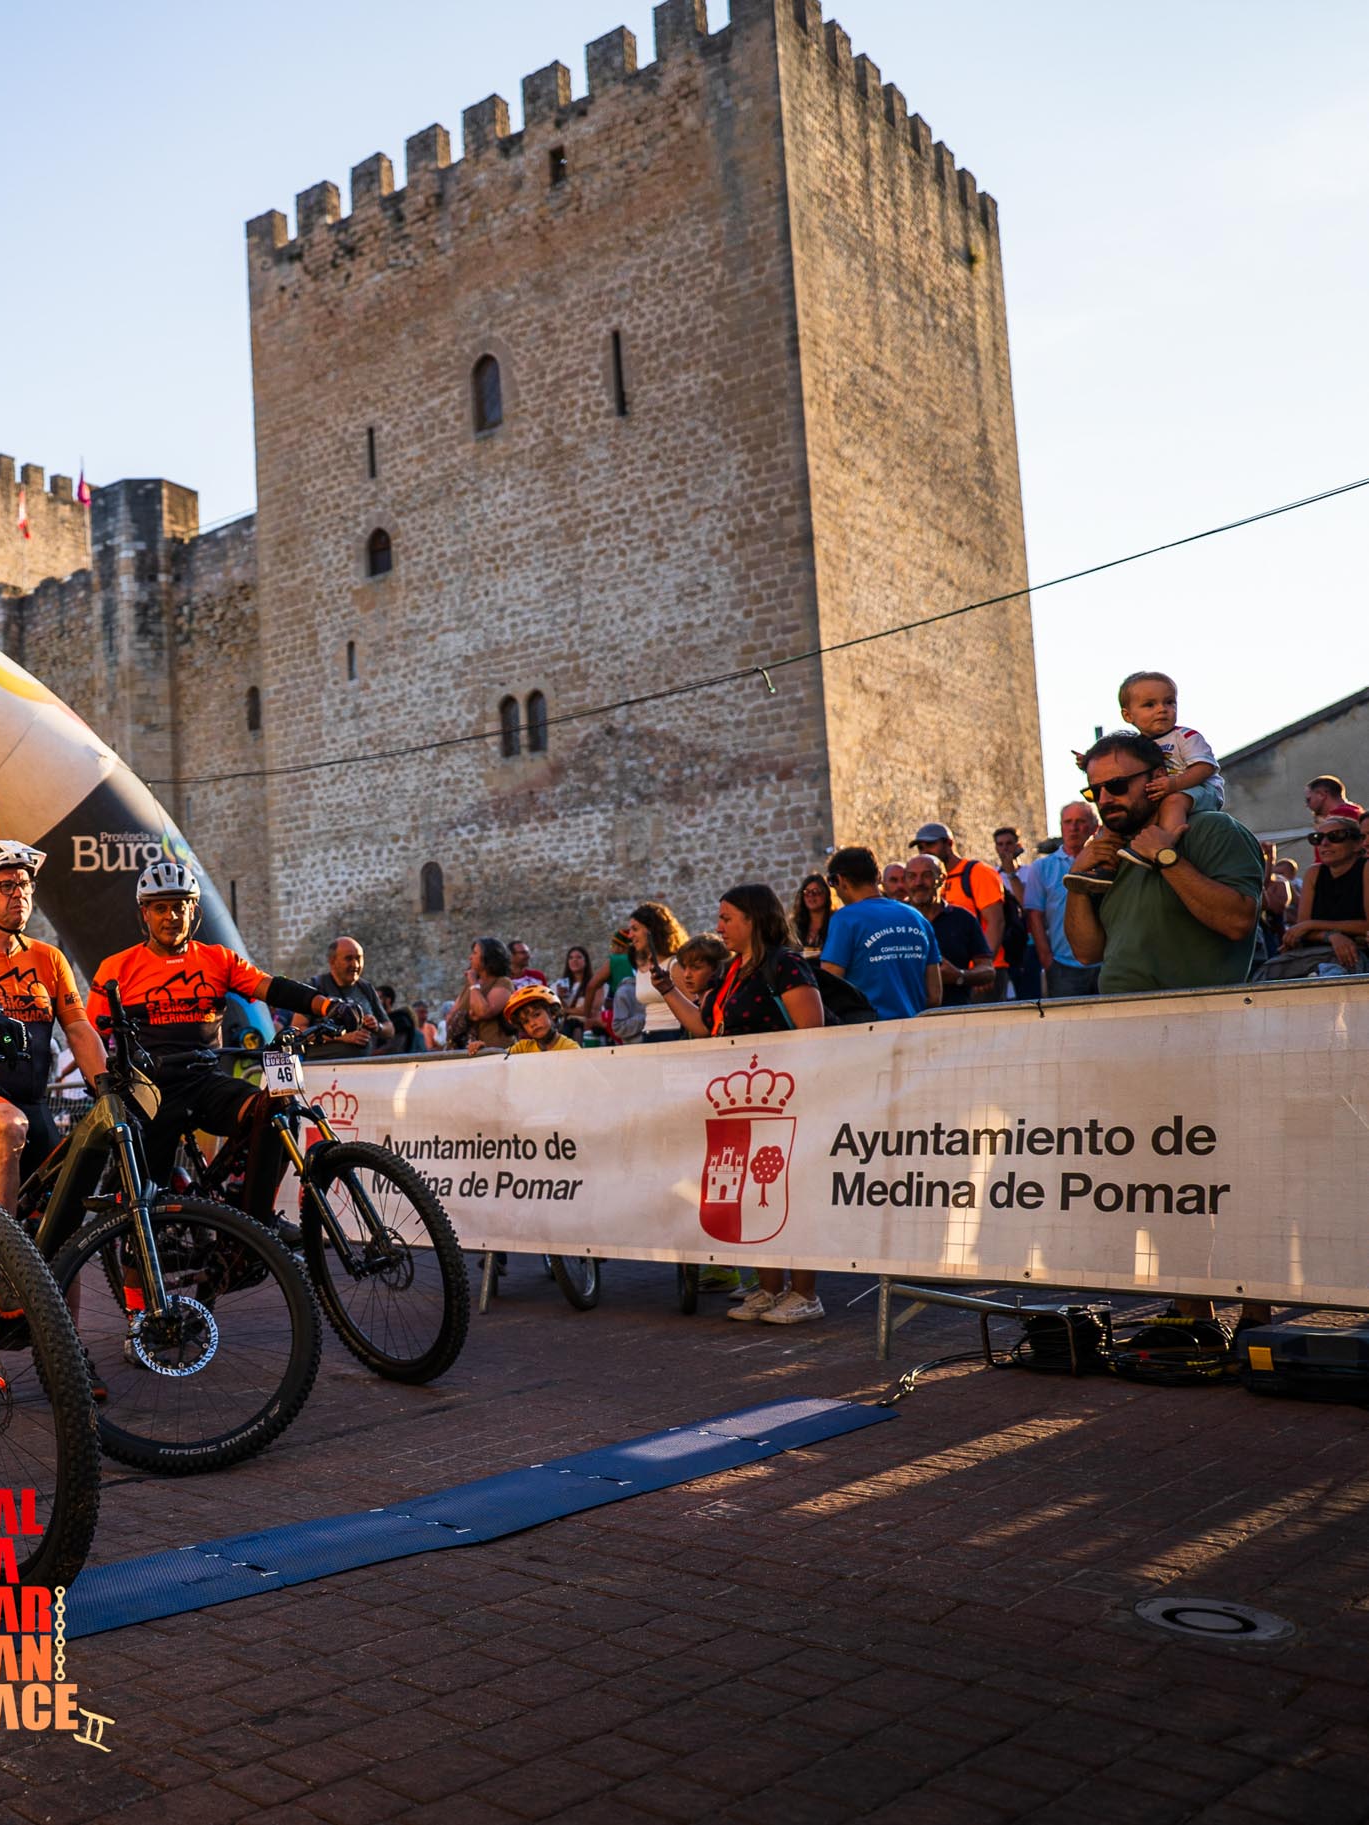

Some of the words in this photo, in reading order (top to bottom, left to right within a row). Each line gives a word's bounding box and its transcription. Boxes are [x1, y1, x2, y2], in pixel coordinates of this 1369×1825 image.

[100, 831, 150, 843] Provincia
[266, 1057, 291, 1066] BURGO
[277, 1066, 293, 1083] 46
[381, 1132, 537, 1161] Ayuntamiento
[544, 1131, 577, 1161] de
[830, 1118, 1135, 1164] Ayuntamiento
[1151, 1115, 1217, 1156] de
[371, 1171, 452, 1198] Meina
[460, 1170, 489, 1198] de
[495, 1171, 583, 1200] Pomar
[831, 1171, 976, 1209] Medina
[989, 1170, 1045, 1209] de
[1060, 1172, 1230, 1214] Pomar
[158, 1444, 218, 1456] MAGIC
[220, 1417, 265, 1449] MARY
